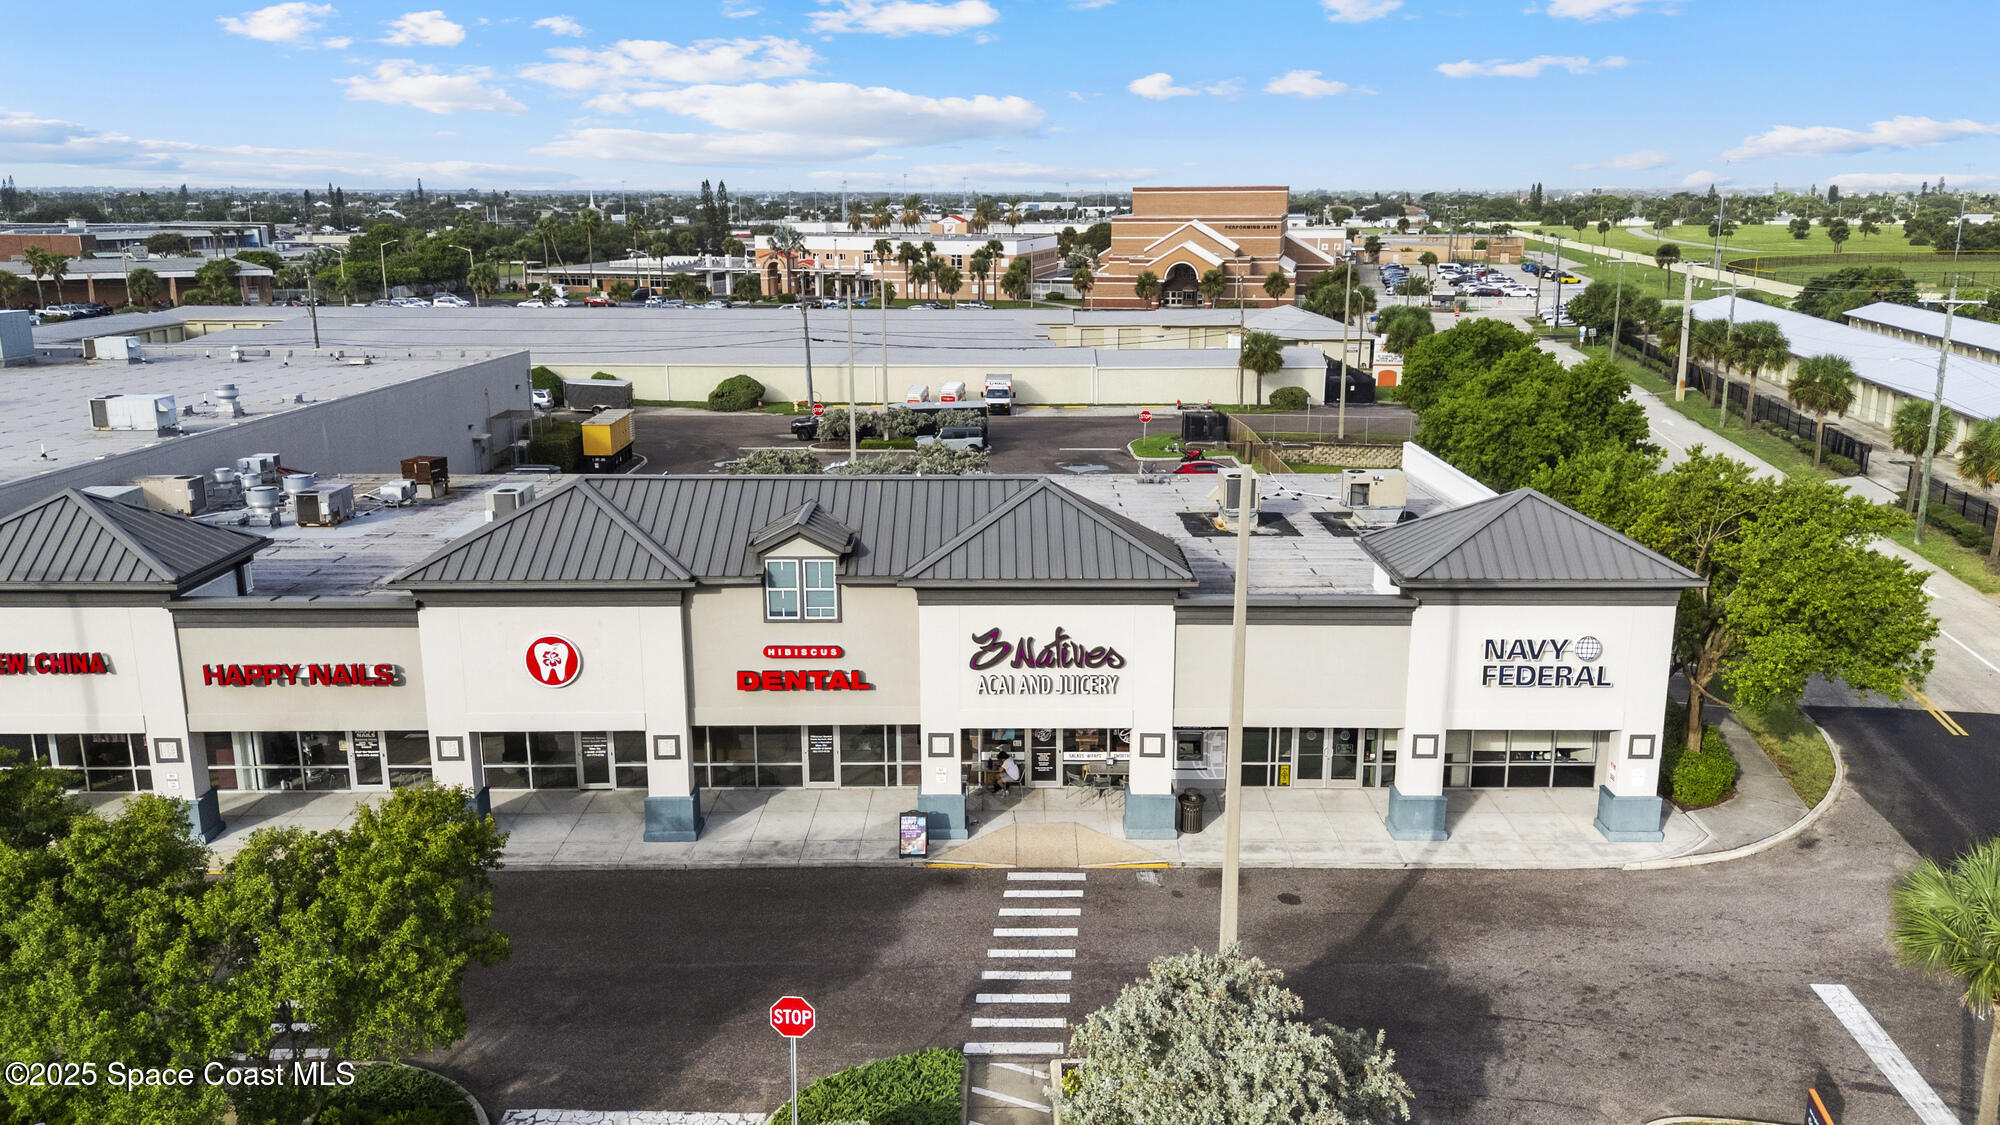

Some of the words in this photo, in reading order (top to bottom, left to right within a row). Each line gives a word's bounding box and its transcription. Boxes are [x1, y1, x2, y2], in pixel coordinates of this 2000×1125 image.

[766, 648, 838, 656] HIBISCUS
[969, 627, 1014, 671] 3
[1010, 626, 1126, 670] Natives
[1484, 639, 1569, 660] NAVY
[34, 651, 108, 675] CHINA
[202, 663, 300, 687] HAPPY
[308, 663, 394, 687] NAILS
[736, 669, 872, 691] DENTAL
[1018, 674, 1053, 695] AND
[1055, 674, 1119, 695] JUICERY
[1482, 665, 1613, 687] FEDERAL
[773, 1008, 812, 1025] STOP
